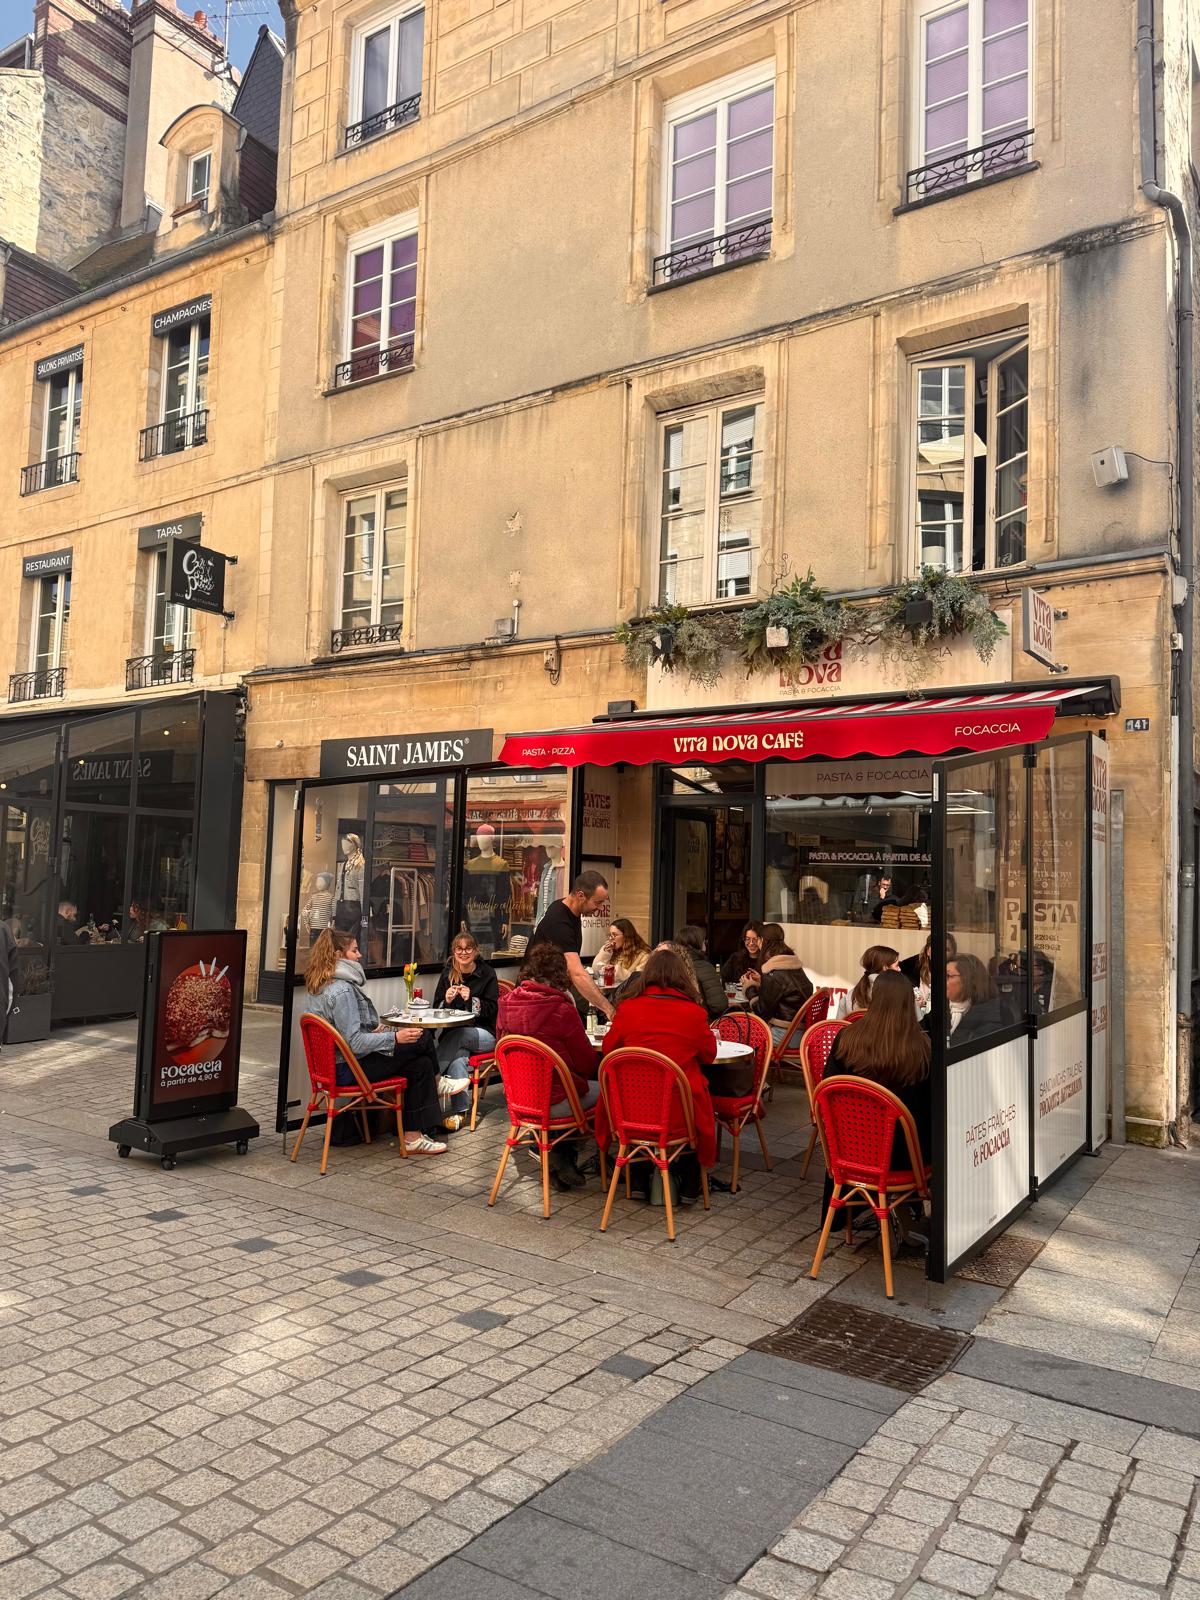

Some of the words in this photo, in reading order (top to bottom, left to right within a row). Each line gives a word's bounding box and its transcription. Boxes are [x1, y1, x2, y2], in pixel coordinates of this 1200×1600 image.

[154, 299, 212, 329] CHAMPAGNES
[37, 359, 58, 375] SALONS
[156, 524, 183, 539] TAPAS
[25, 555, 71, 572] RESTAURANT
[954, 722, 1021, 737] FOCACCIA
[761, 730, 804, 750] CAFÉ
[346, 743, 400, 768] SAINT
[522, 747, 546, 757] PASTA
[551, 746, 576, 756] PIZZA
[816, 772, 853, 783] PASTA
[855, 771, 864, 781] &
[867, 769, 929, 781] FOCACCIA
[583, 790, 611, 809] PÂTES
[808, 852, 830, 860] PASTA
[837, 852, 875, 861] FOCACCIA
[909, 853, 920, 862] DE
[1006, 901, 1078, 924] PSTA
[582, 918, 611, 929] ONHEUR
[166, 1077, 187, 1088] partir
[198, 1073, 213, 1082] 4,90
[966, 1121, 987, 1148] PÂTES
[973, 1148, 979, 1168] &
[980, 1127, 1011, 1164] FOCACCIA
